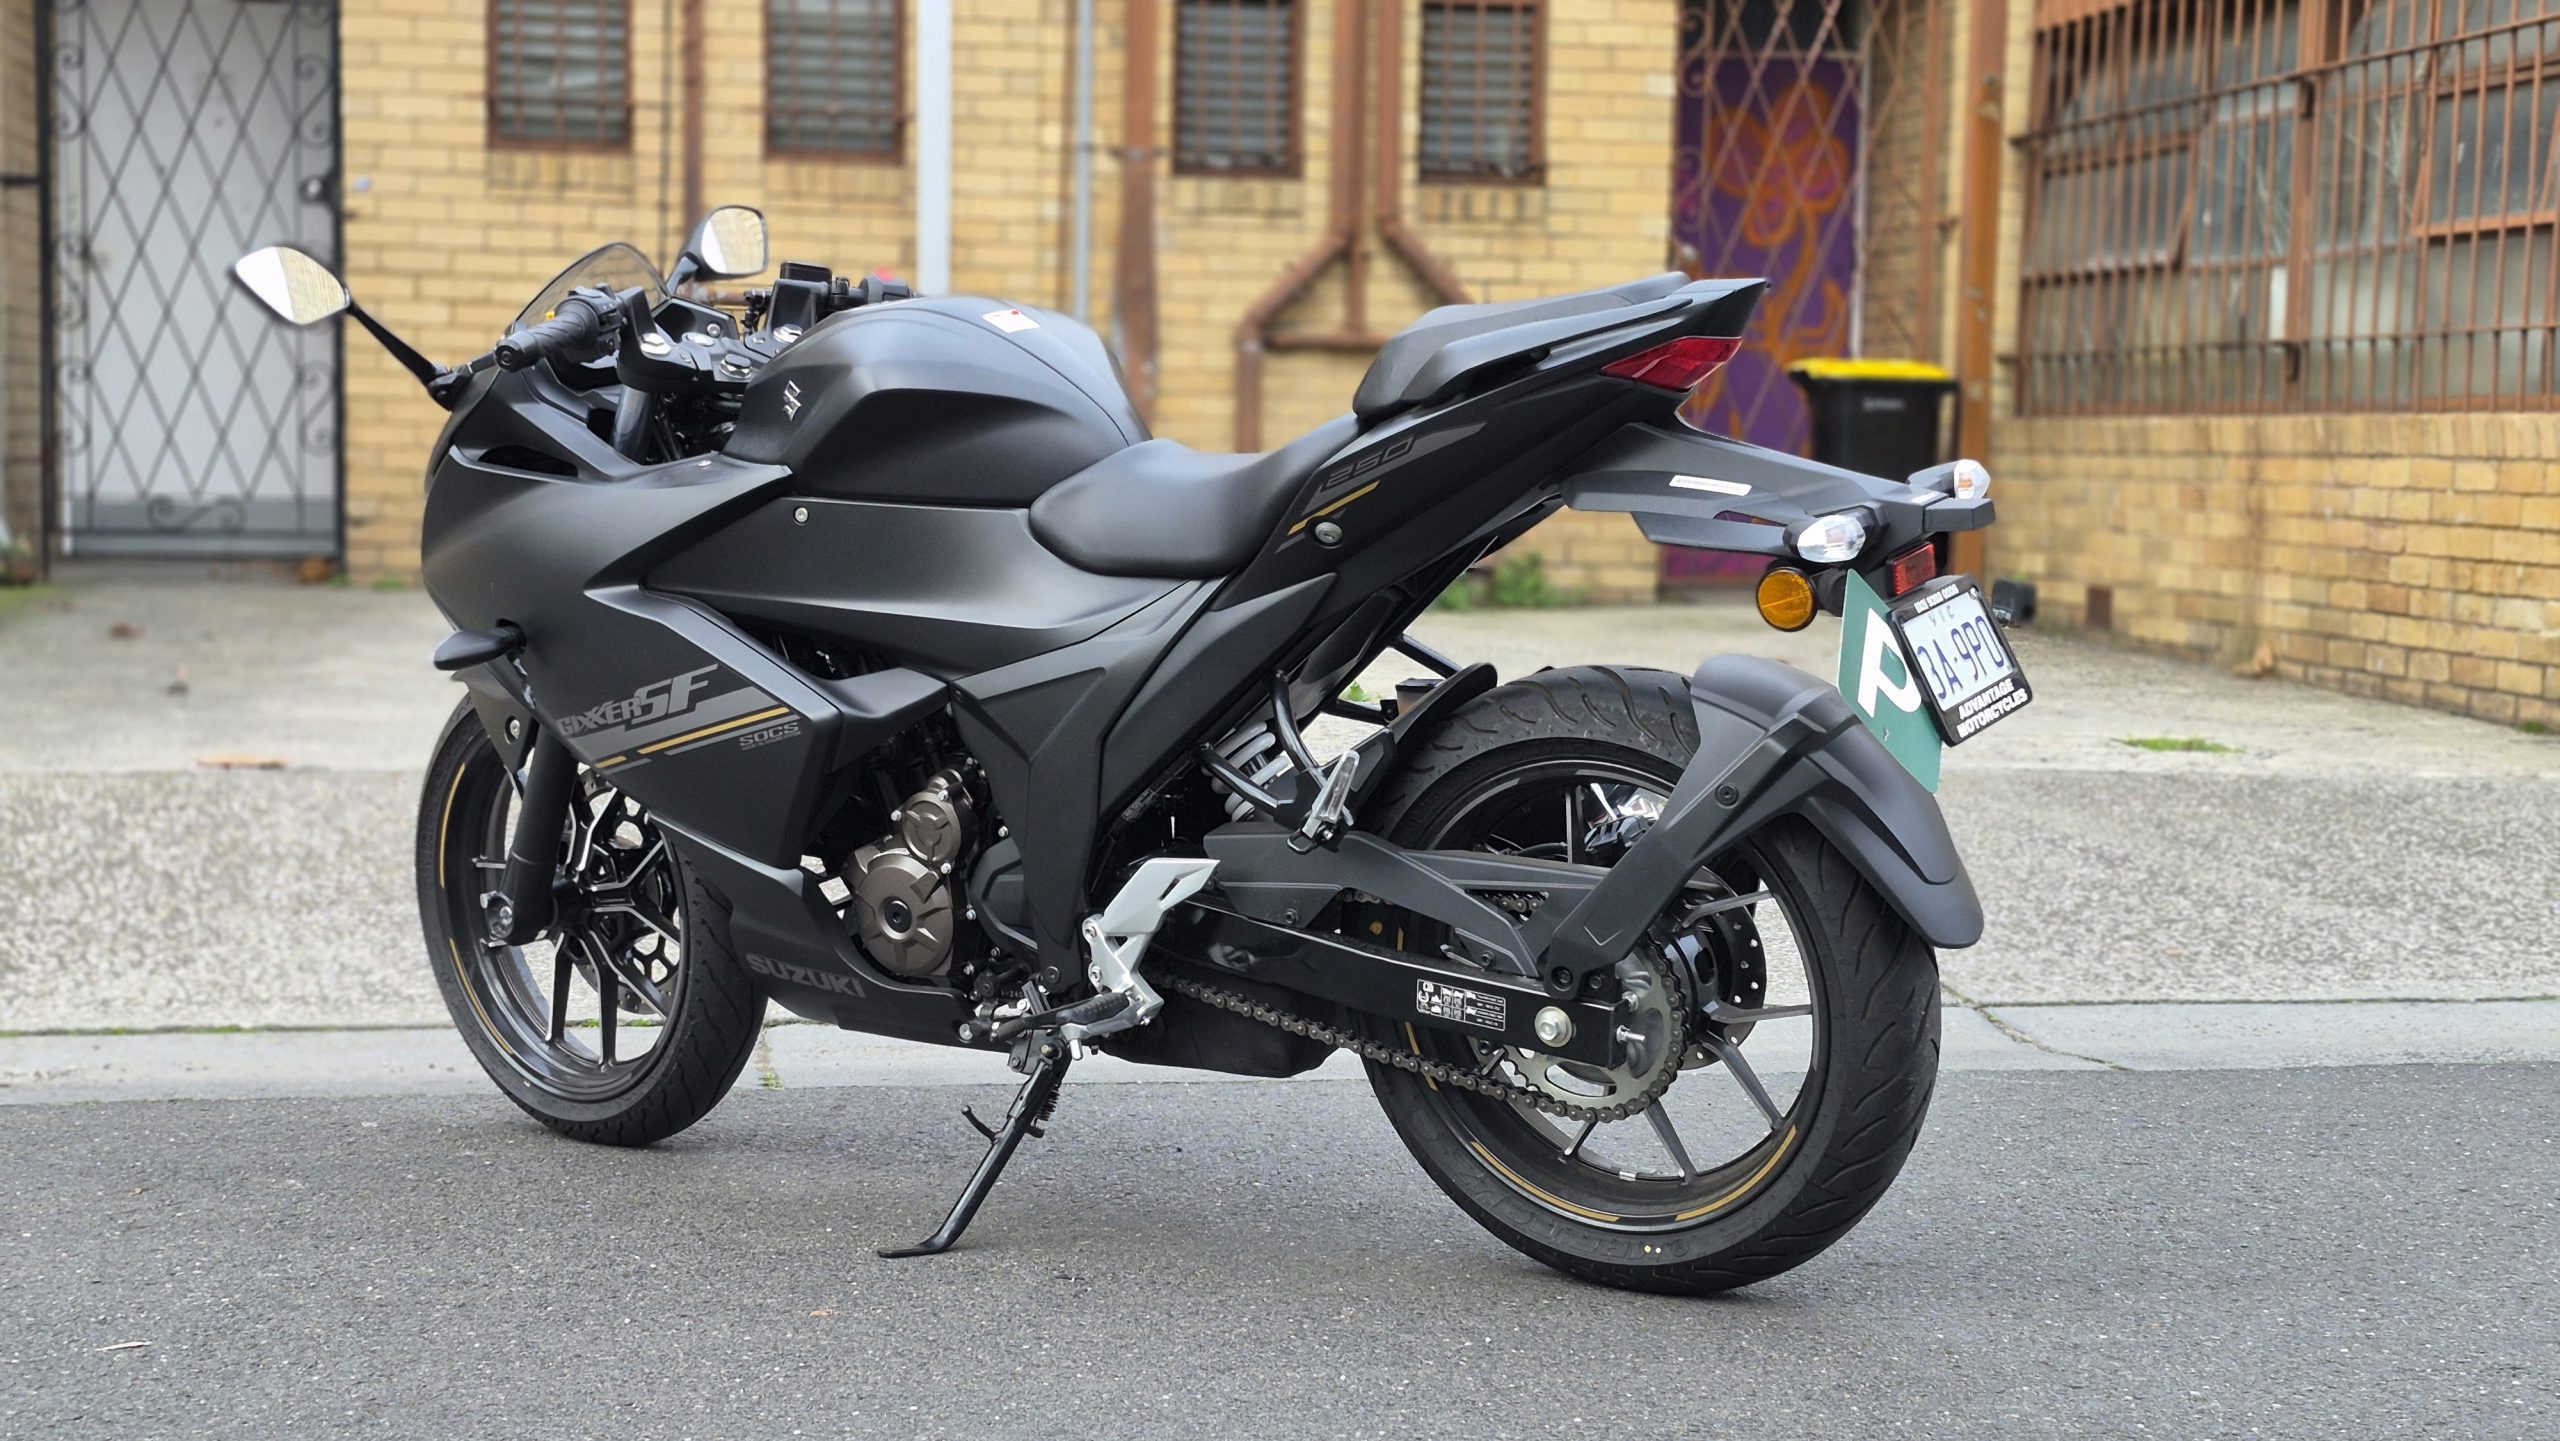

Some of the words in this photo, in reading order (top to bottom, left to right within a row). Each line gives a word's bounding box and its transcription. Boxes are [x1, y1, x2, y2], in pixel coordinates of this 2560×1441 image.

[1326, 436, 1414, 488] 250
[1857, 607, 1922, 718] P
[1956, 688, 2028, 738] MOTORCYCLES
[1958, 677, 2015, 720] ADVANTAGE
[739, 721, 799, 747] SOCS
[745, 951, 867, 999] SUZUKI
